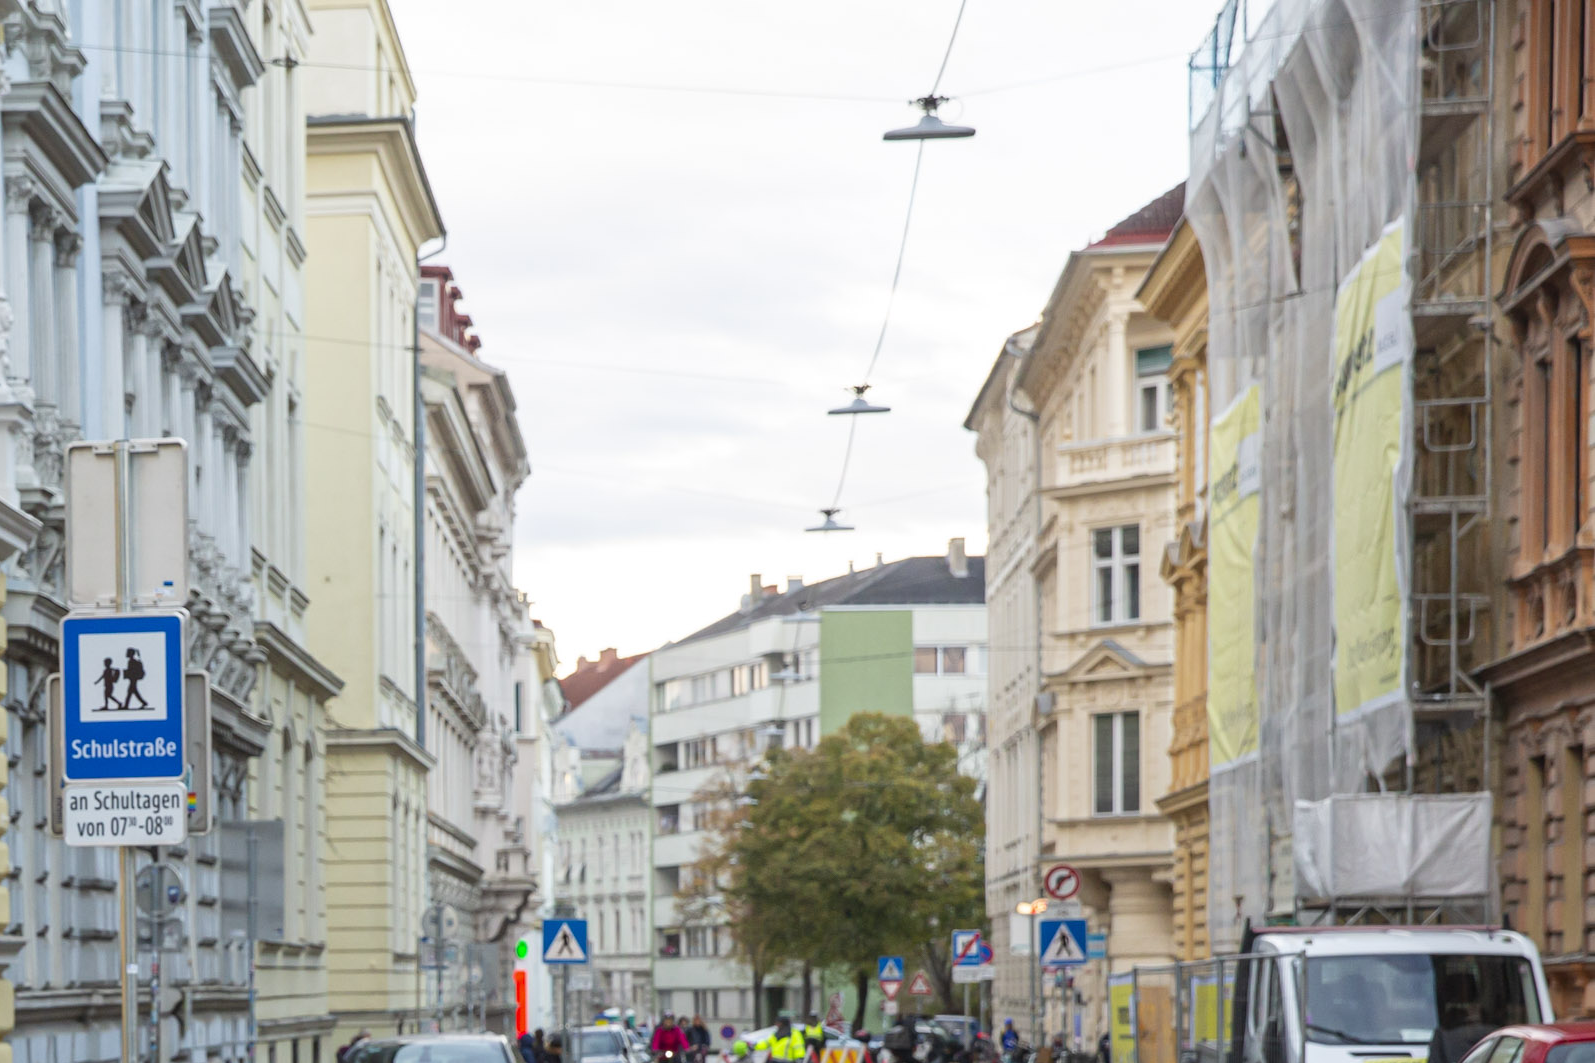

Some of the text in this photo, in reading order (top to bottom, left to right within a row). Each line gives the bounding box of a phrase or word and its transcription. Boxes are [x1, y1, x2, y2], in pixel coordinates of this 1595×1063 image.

[71, 737, 177, 759] Schulstraße
[70, 795, 88, 811] an
[94, 790, 180, 814] Schultagen
[77, 821, 105, 836] von
